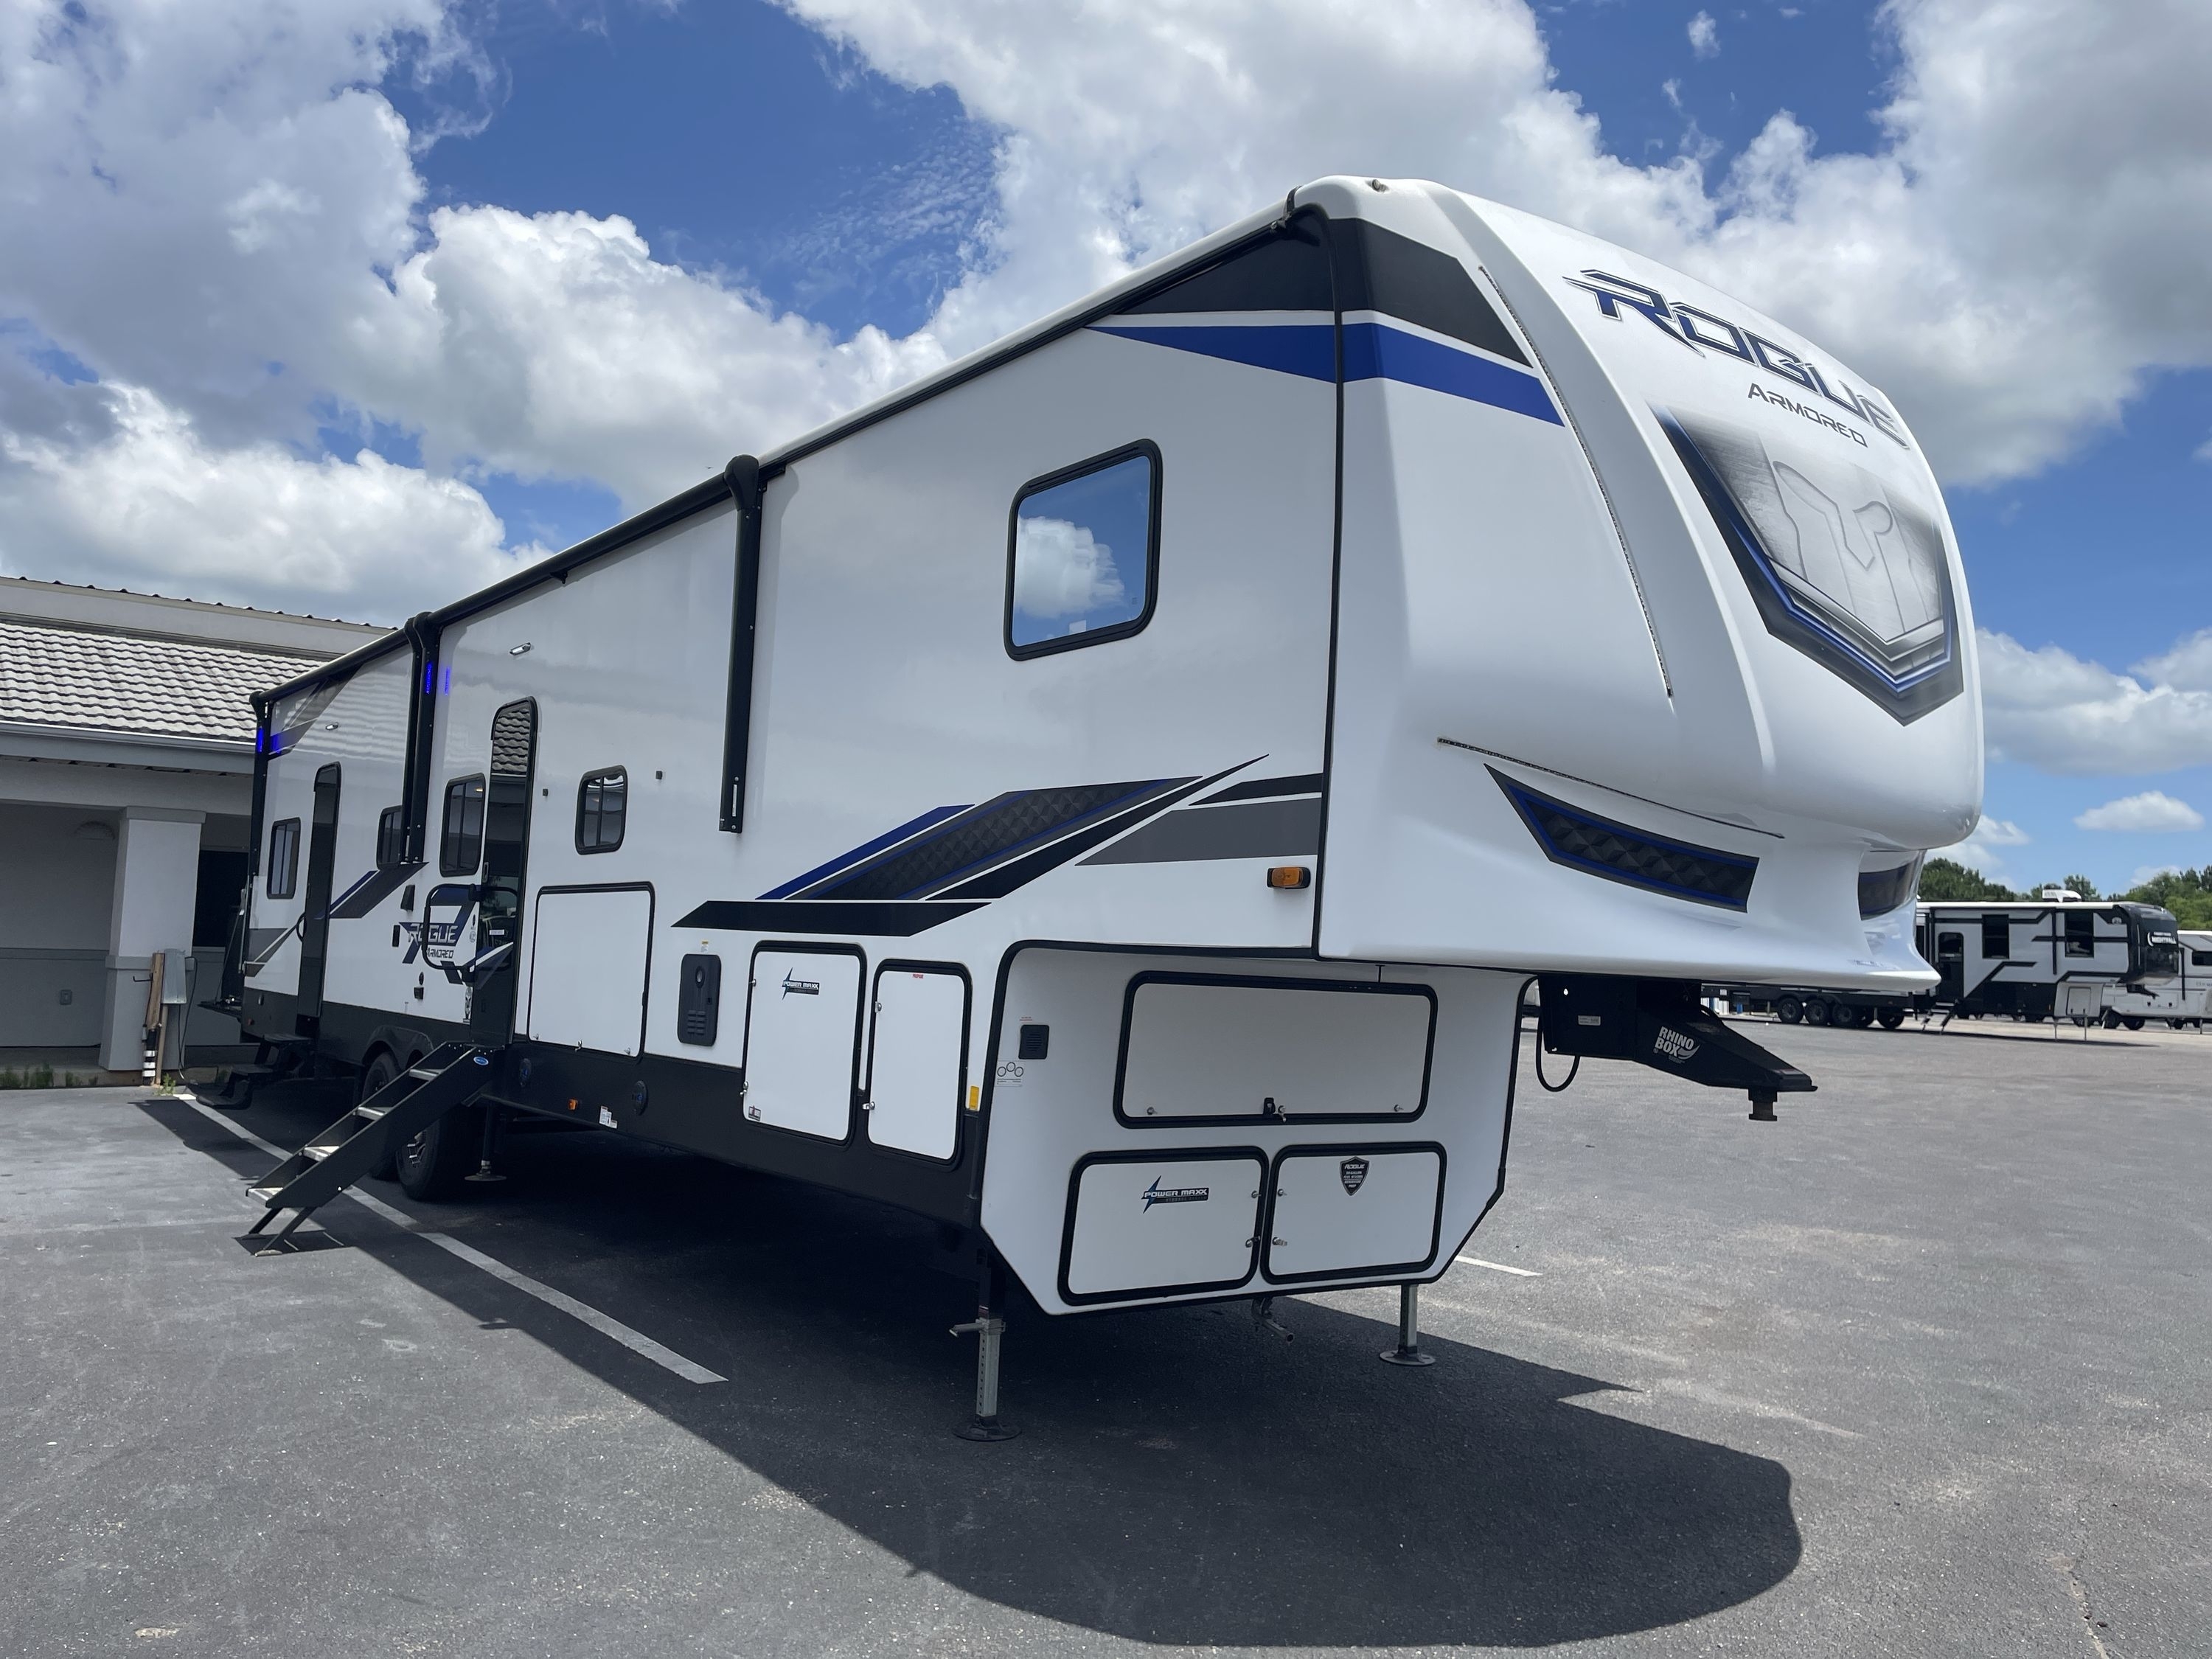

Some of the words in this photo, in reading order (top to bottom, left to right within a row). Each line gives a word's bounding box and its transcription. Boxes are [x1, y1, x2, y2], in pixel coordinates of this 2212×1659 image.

[1562, 269, 1909, 450] ROGUE
[1747, 383, 1868, 448] ARMORED
[1655, 1037, 1680, 1057] BOX
[1659, 1026, 1694, 1050] RHINO
